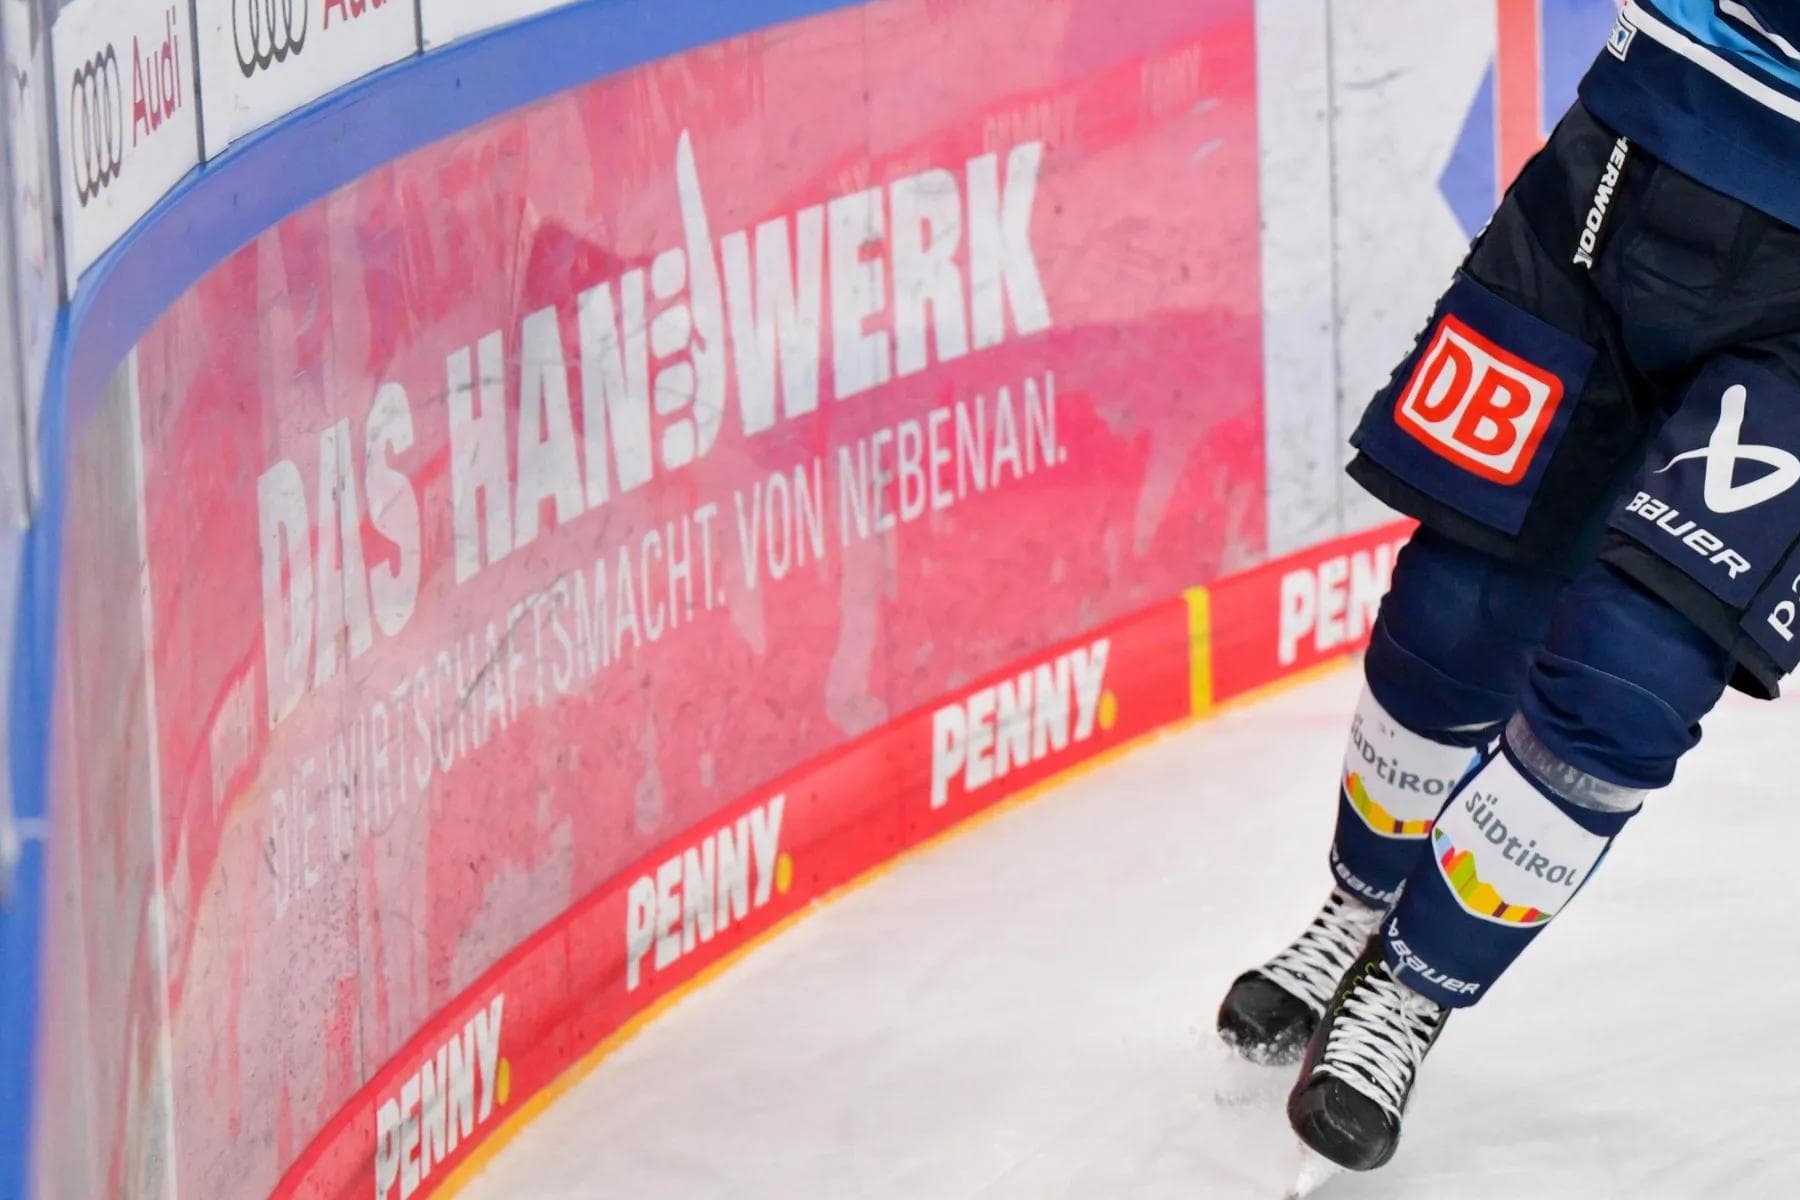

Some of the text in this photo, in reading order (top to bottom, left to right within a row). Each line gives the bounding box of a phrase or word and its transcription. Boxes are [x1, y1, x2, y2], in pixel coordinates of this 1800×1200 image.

[132, 6, 182, 148] Audi
[1410, 338, 1533, 456] DB
[257, 381, 422, 733] DAS
[735, 462, 826, 601] VON
[1627, 490, 1752, 581] BAUER
[1278, 537, 1410, 667] PEN
